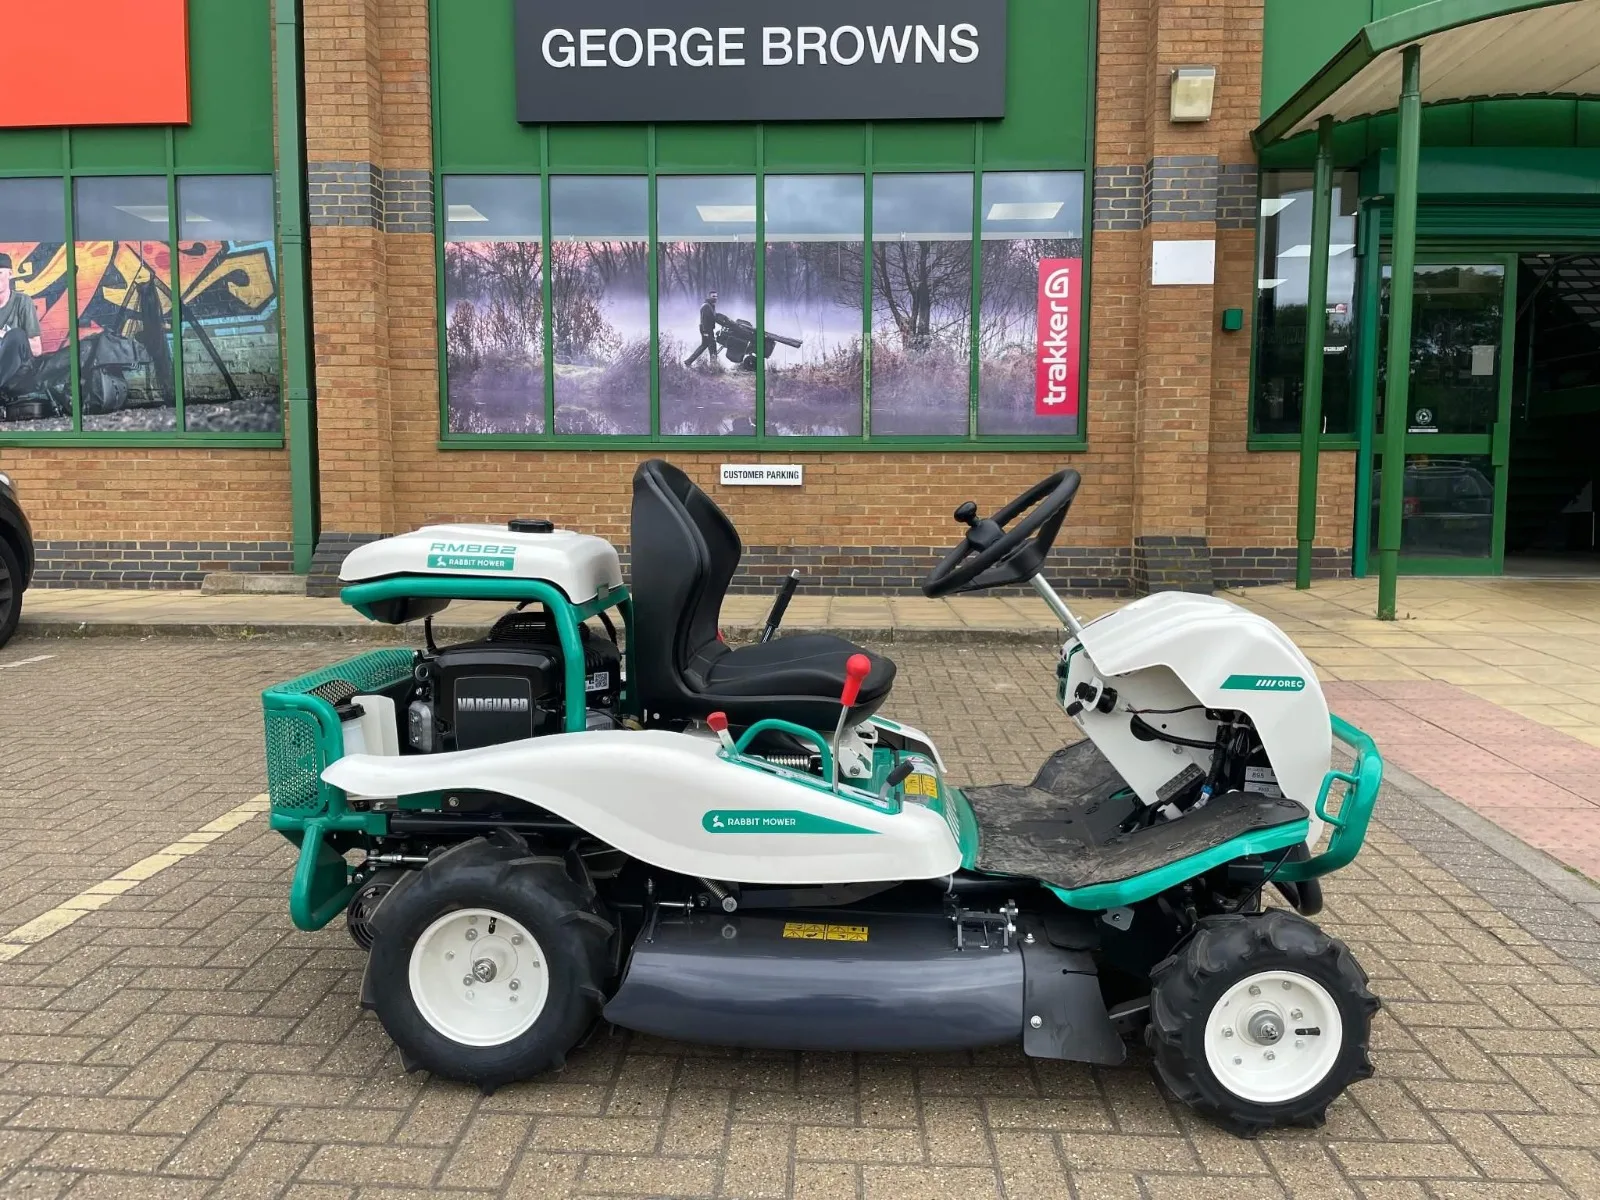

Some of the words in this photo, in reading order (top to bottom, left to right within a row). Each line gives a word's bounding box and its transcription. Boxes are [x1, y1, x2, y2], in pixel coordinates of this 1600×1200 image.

[541, 27, 746, 68] GEORGE
[762, 23, 979, 66] BROWNS
[1042, 300, 1069, 406] trakker
[723, 470, 764, 479] CUSTOMER
[766, 470, 799, 480] PARKING
[430, 542, 517, 555] RM882
[448, 558, 476, 566] RABBIT
[477, 559, 505, 568] MOWER
[1277, 680, 1303, 688] OREC
[457, 697, 528, 712] VANGUARD
[727, 817, 760, 826] RABBIT
[762, 817, 796, 826] MOWER
